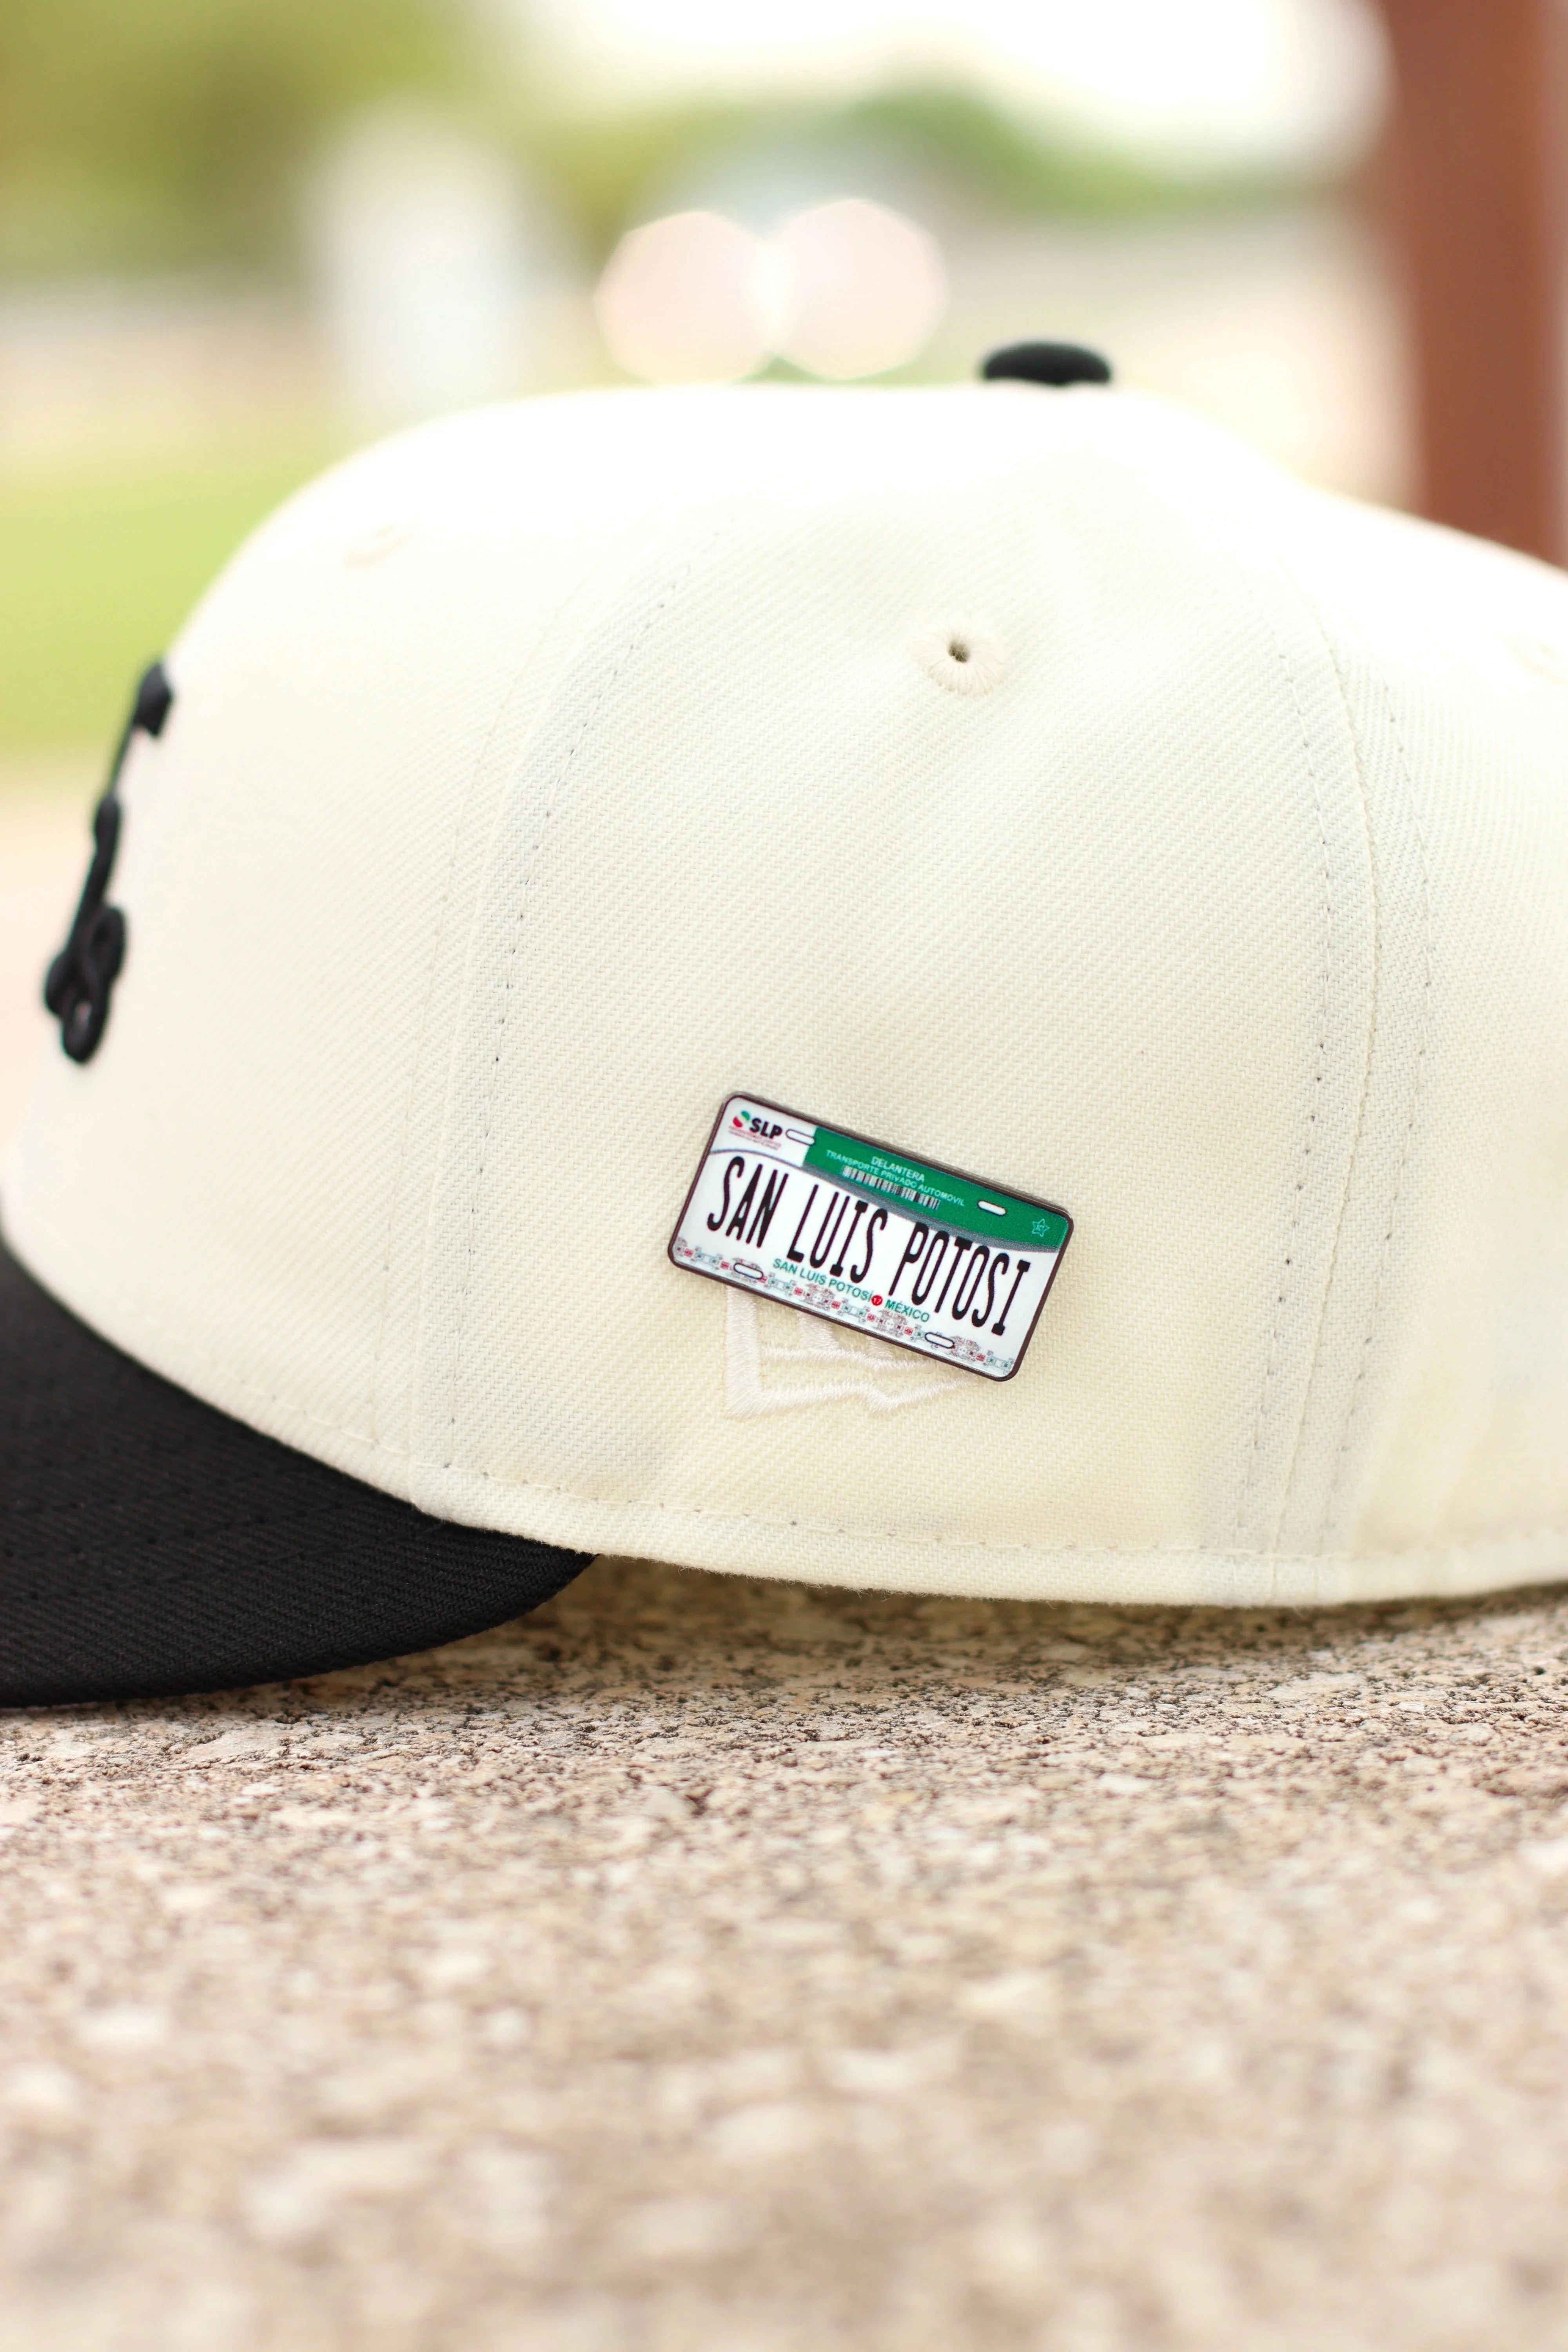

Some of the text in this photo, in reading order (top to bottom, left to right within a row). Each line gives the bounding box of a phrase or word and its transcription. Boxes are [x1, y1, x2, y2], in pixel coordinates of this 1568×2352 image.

[750, 1118, 783, 1139] SLP
[826, 1149, 879, 1175] TRANSPORTE
[880, 1171, 917, 1189] PRIVADO
[871, 1156, 925, 1182] DELANTERA
[707, 1156, 1031, 1335] SAN LUIS POTOSI
[773, 1258, 798, 1275] SAN
[799, 1268, 828, 1285] LUIS
[829, 1278, 874, 1302] POTOSÍ
[884, 1299, 930, 1323] MÉXICO
